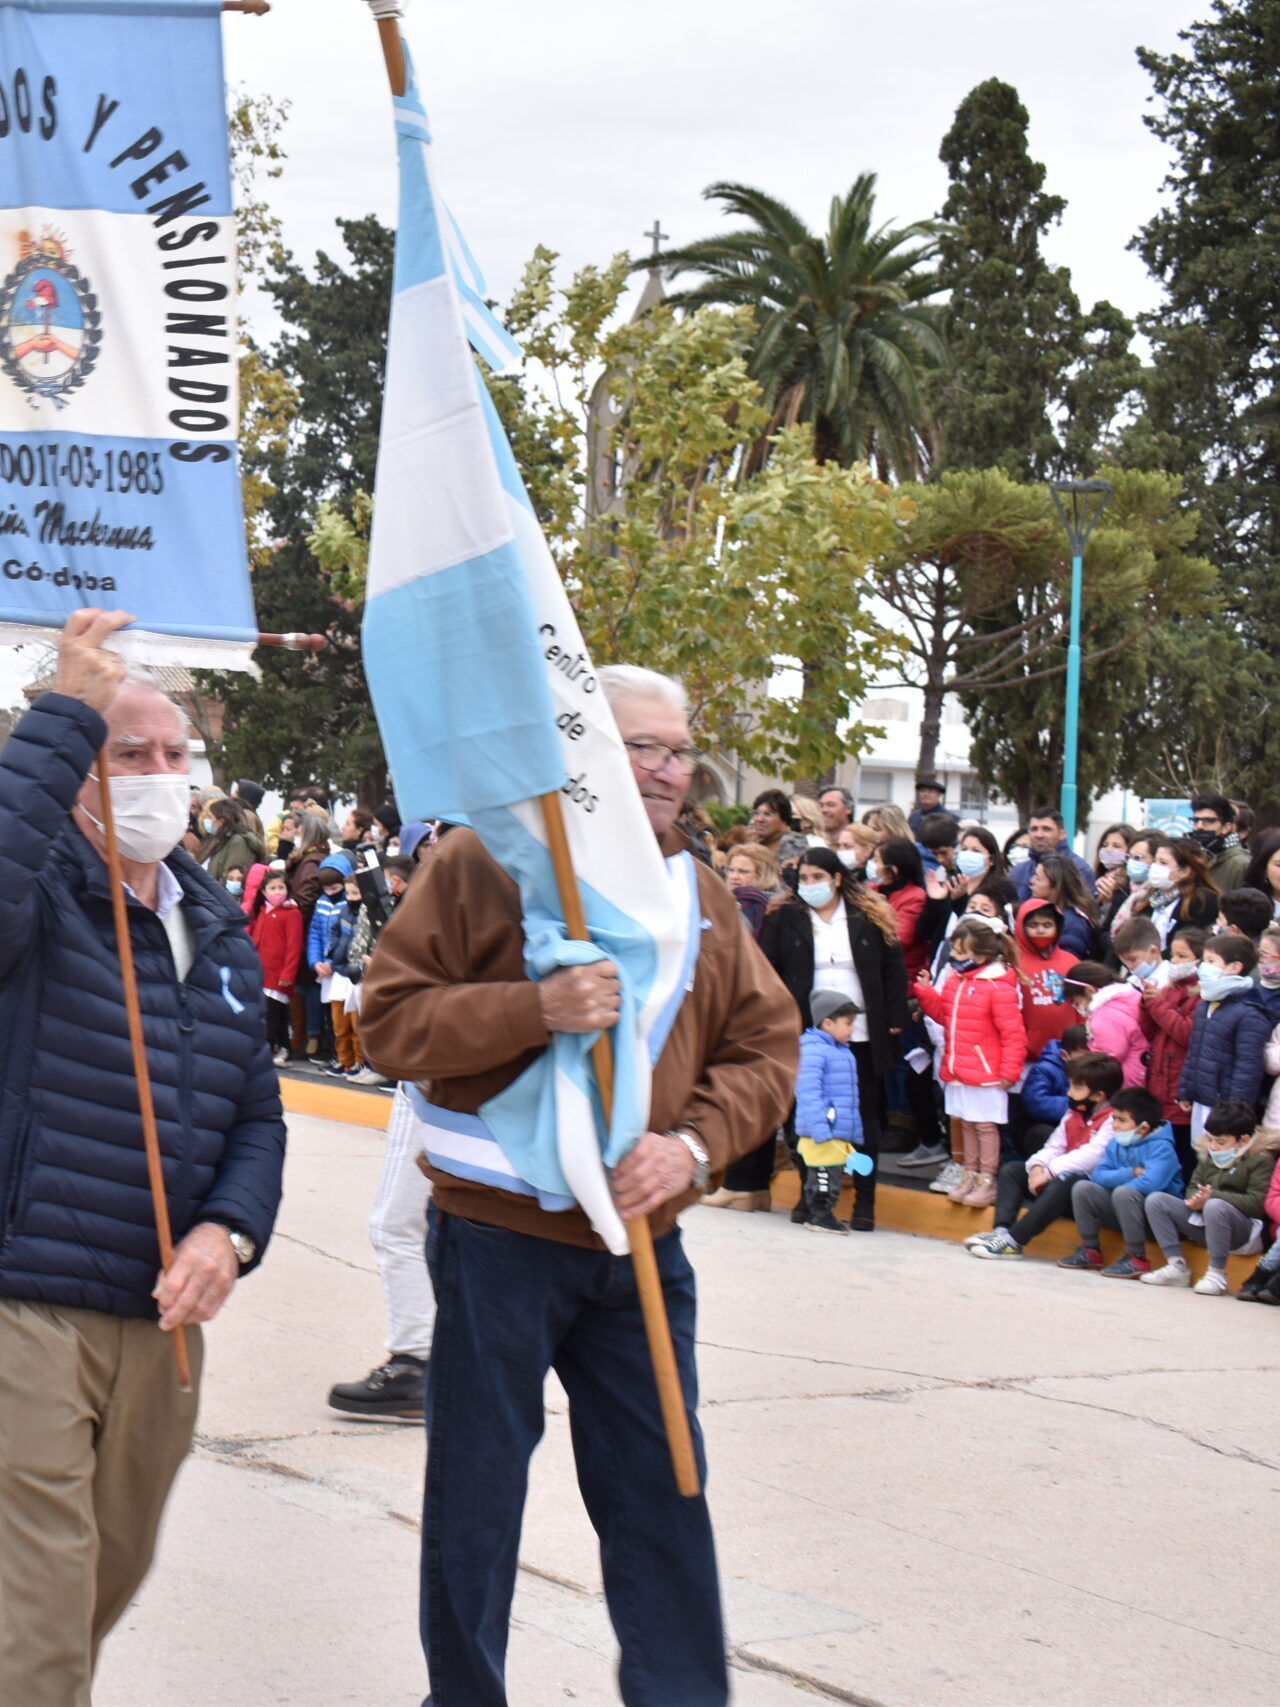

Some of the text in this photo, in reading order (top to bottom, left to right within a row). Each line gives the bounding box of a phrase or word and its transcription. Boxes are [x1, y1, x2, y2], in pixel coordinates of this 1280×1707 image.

[84, 93, 119, 153] Y
[109, 127, 230, 463] PENSIONADOS
[3, 558, 117, 592] Códoba
[556, 711, 587, 741] de
[560, 772, 600, 813] dos
